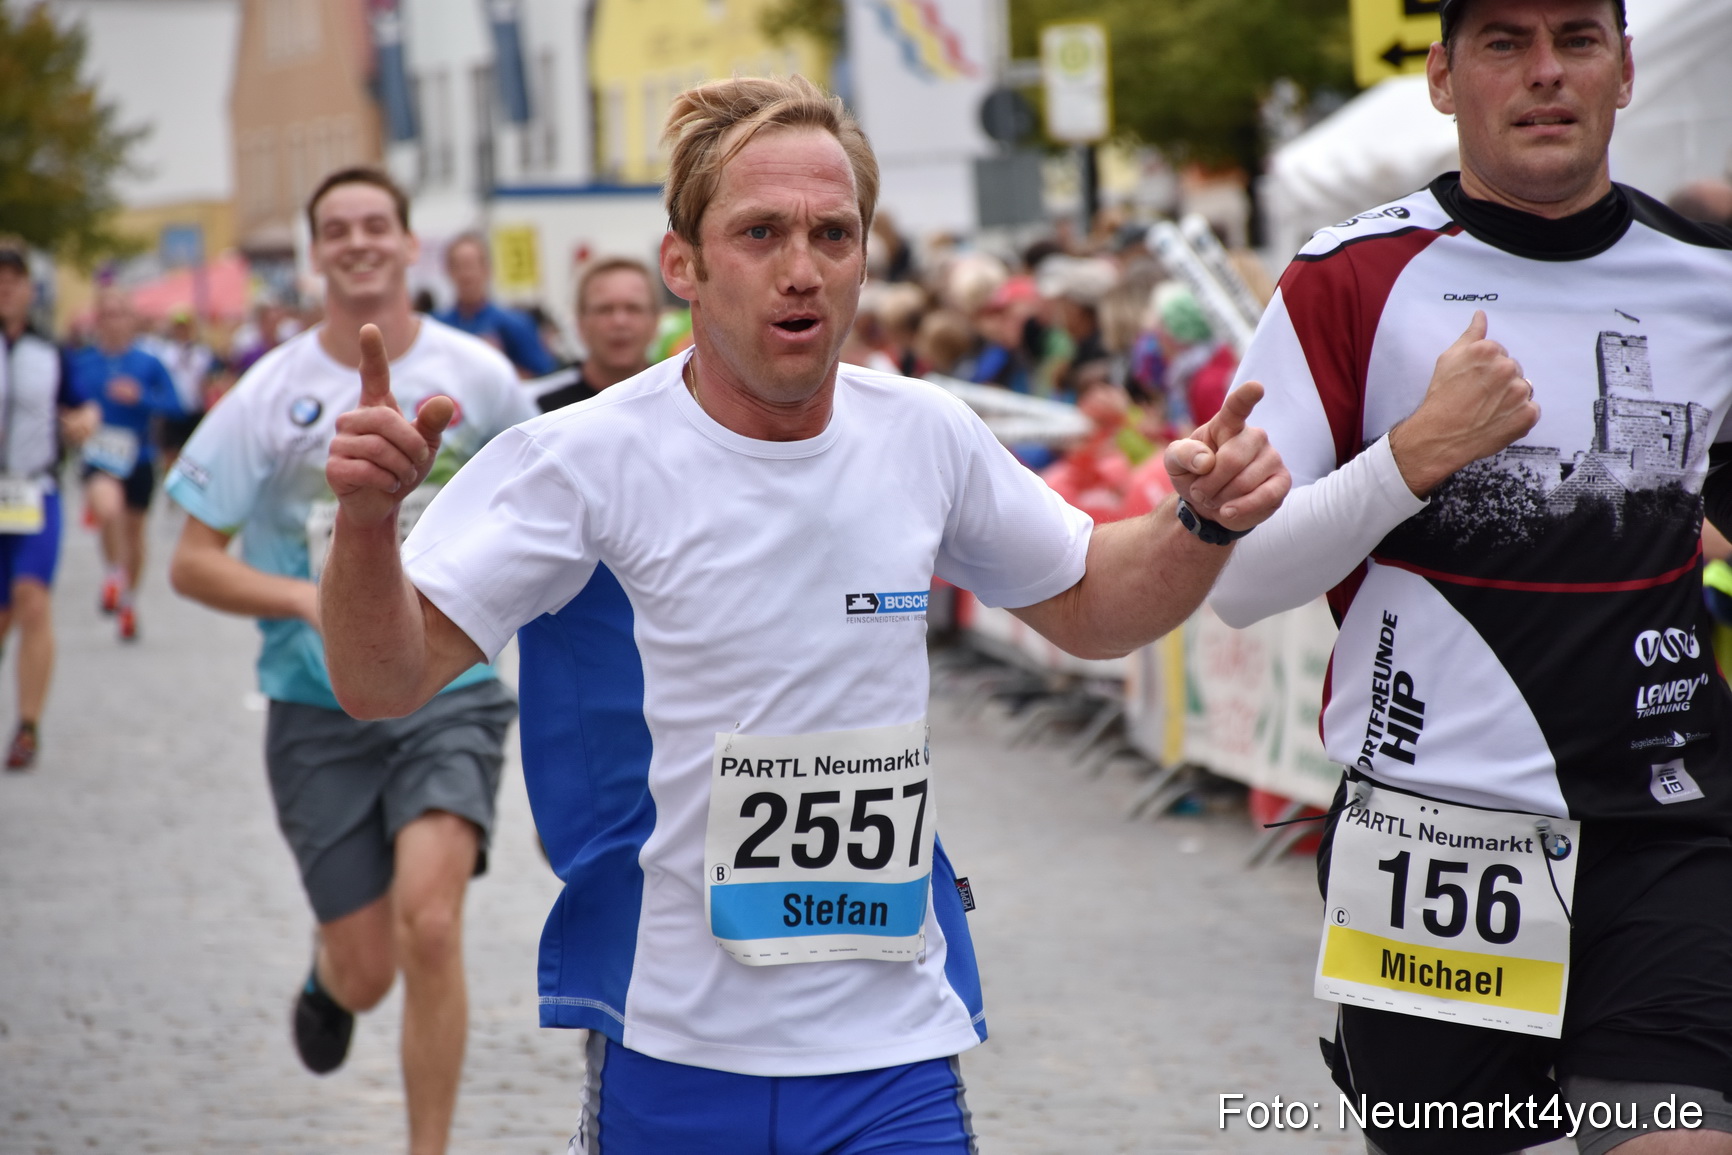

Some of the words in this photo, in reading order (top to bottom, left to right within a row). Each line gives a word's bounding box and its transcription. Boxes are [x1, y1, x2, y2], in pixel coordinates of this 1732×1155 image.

[1378, 670, 1426, 766] HIP
[1636, 701, 1691, 720] TRAINING
[1630, 735, 1673, 750] Segelschule
[720, 756, 808, 779] PARTL
[813, 748, 921, 777] Neumarkt
[733, 777, 929, 871] 2557
[1345, 808, 1412, 839] PARTL
[1418, 822, 1534, 854] Neumarkt
[715, 866, 726, 882] B
[782, 893, 889, 928] Stefan
[1377, 849, 1524, 946] 156
[1335, 909, 1346, 925] C
[1380, 948, 1504, 998] Michael
